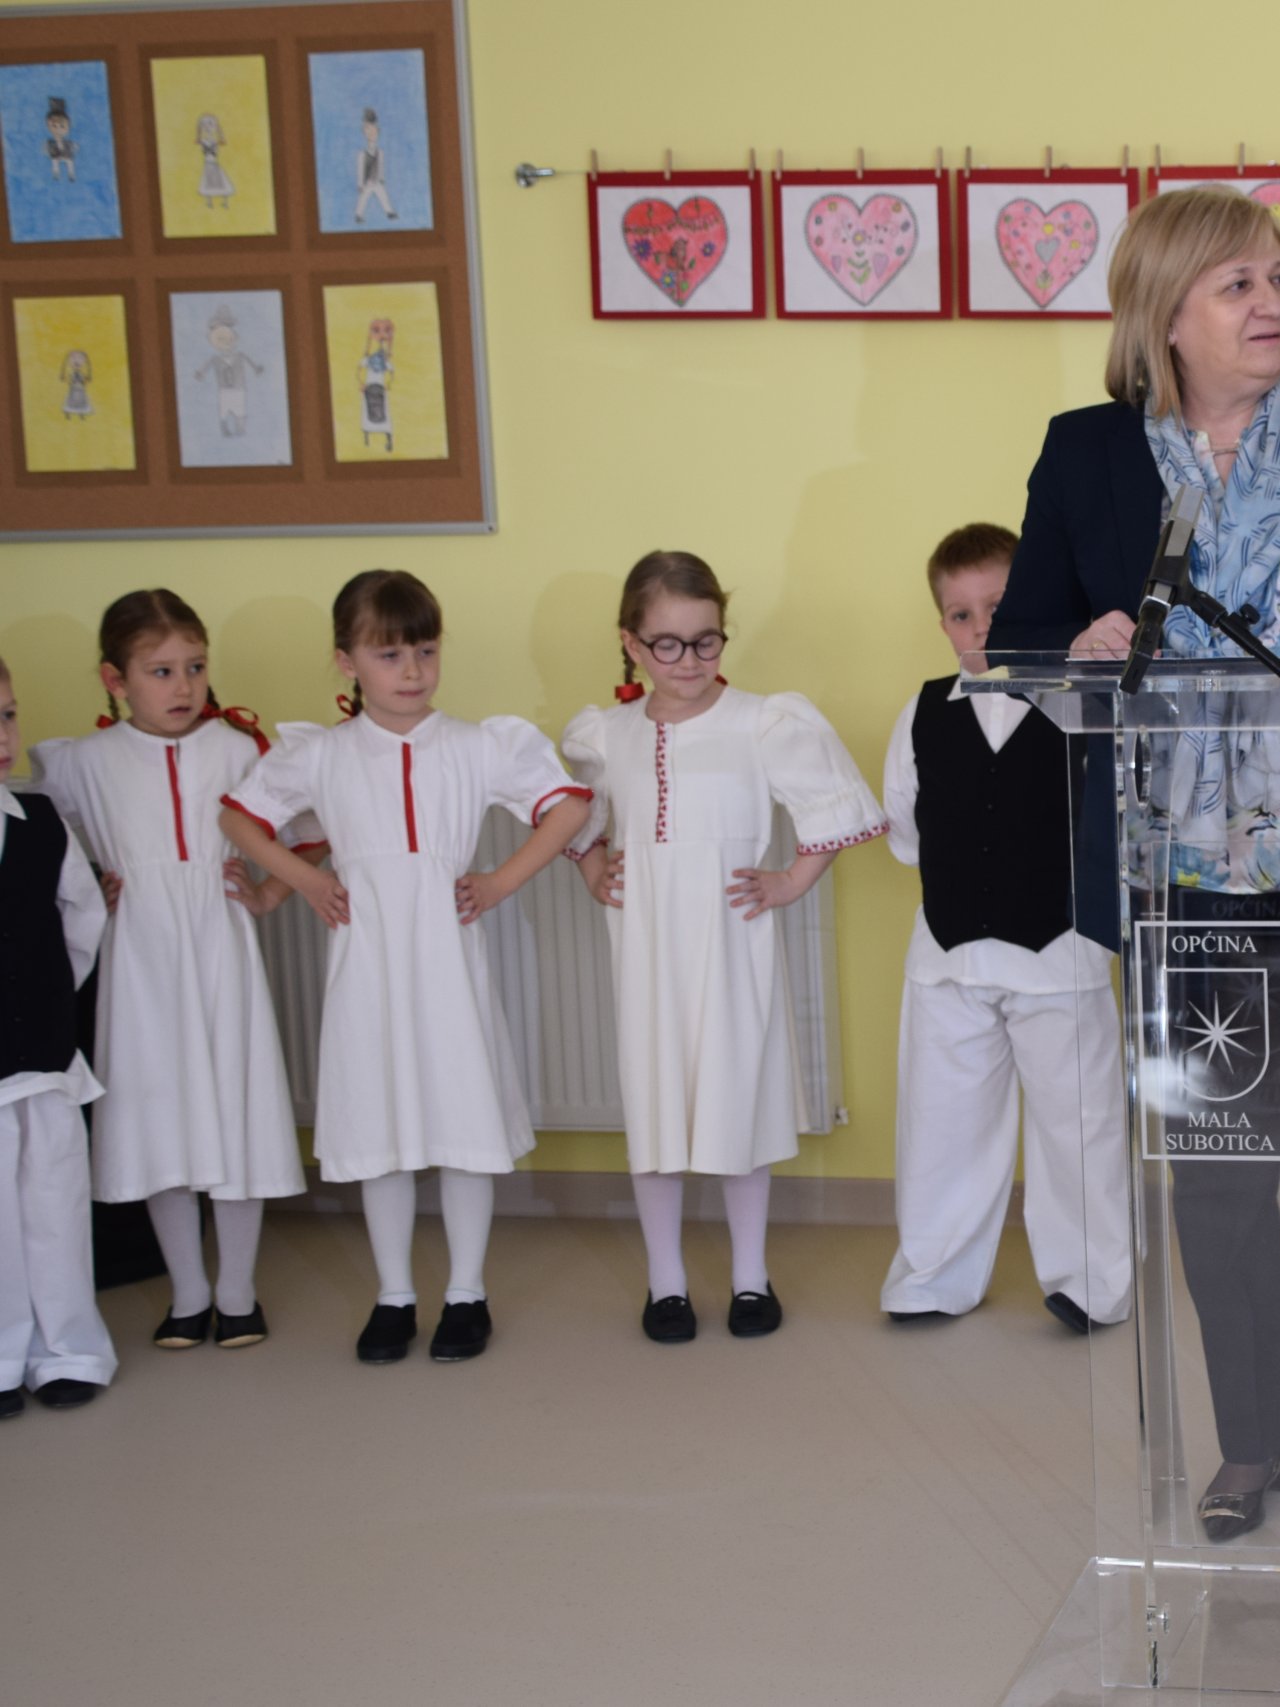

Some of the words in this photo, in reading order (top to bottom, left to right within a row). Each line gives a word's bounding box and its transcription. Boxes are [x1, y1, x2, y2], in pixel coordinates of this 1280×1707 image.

[1171, 931, 1257, 953] OPĆINA
[1187, 1111, 1251, 1128] MALA
[1166, 1134, 1275, 1151] SUBOTICA
